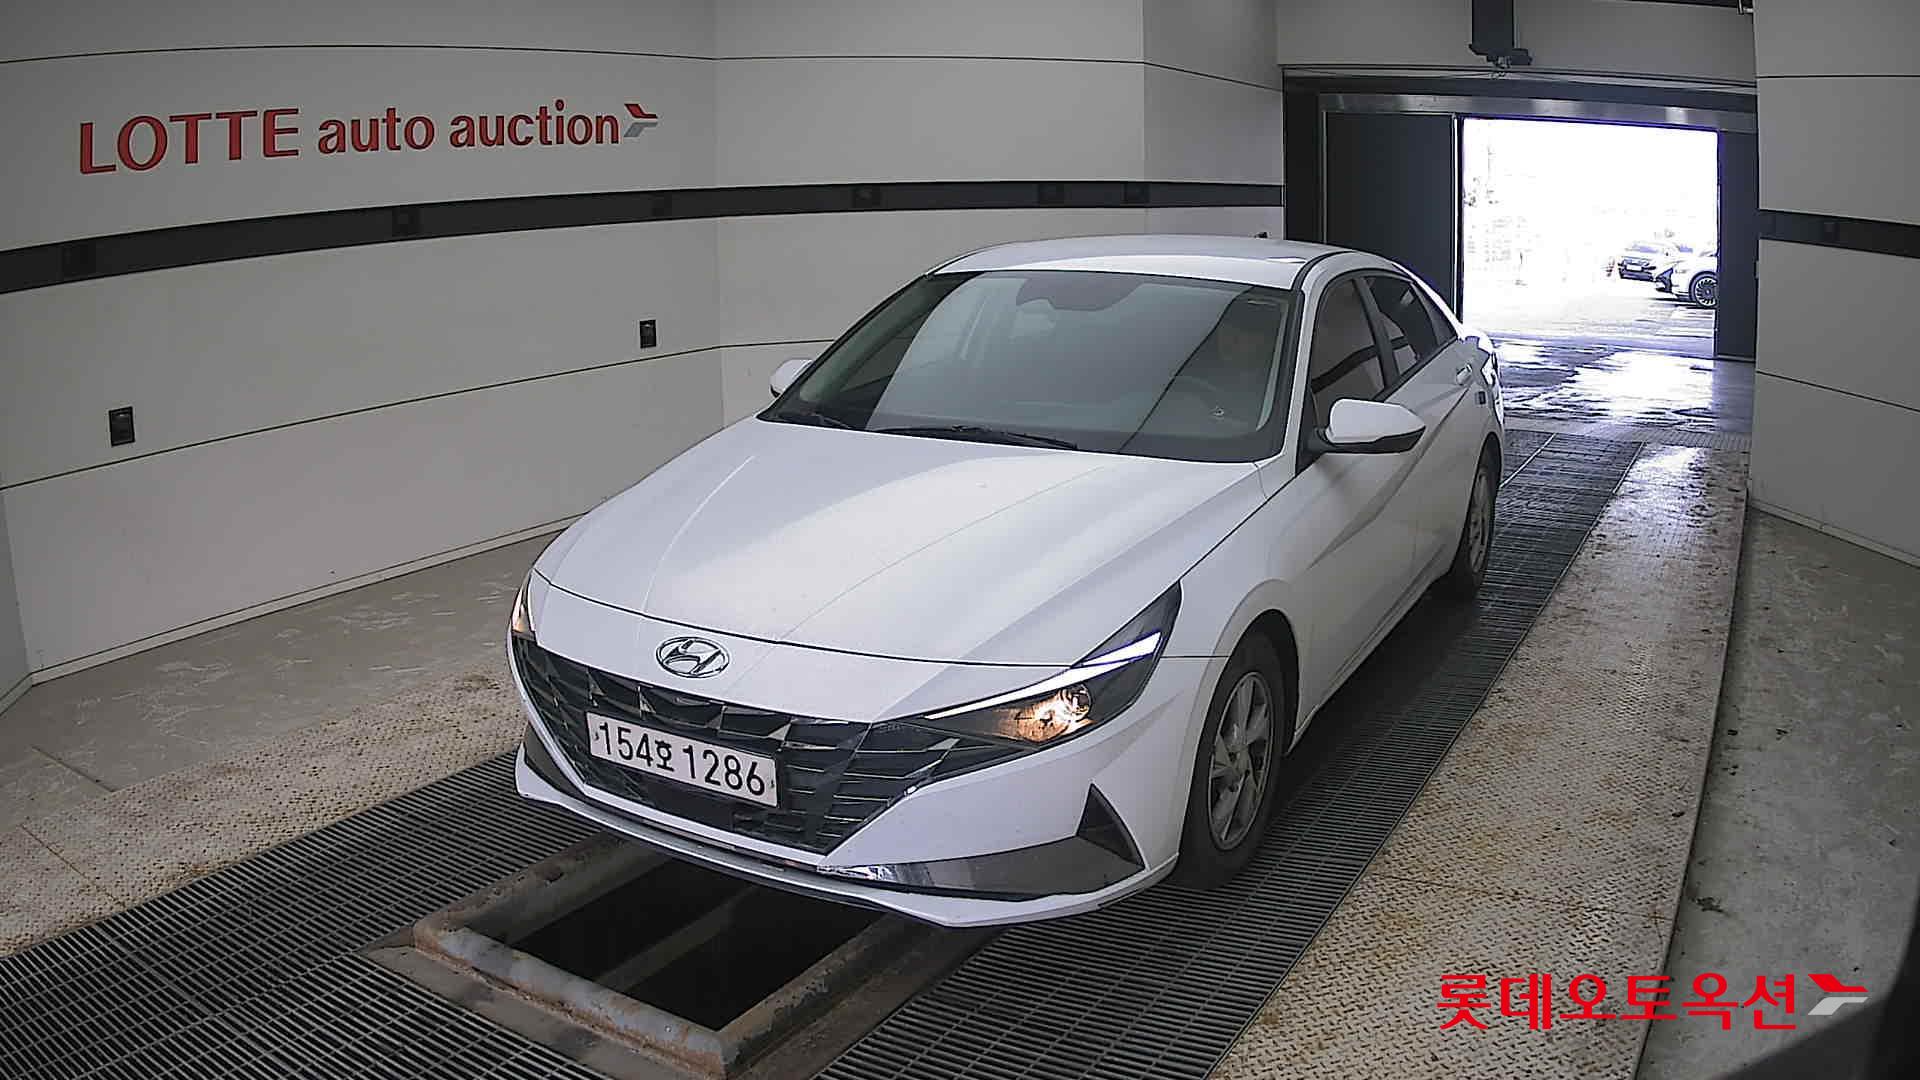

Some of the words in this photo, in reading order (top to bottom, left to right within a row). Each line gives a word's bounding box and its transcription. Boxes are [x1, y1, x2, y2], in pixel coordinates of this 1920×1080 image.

[80, 108, 299, 175] LOTTE
[318, 107, 435, 154] auto
[449, 99, 620, 148] auction
[599, 722, 675, 772] 154호
[682, 744, 766, 796] 1286
